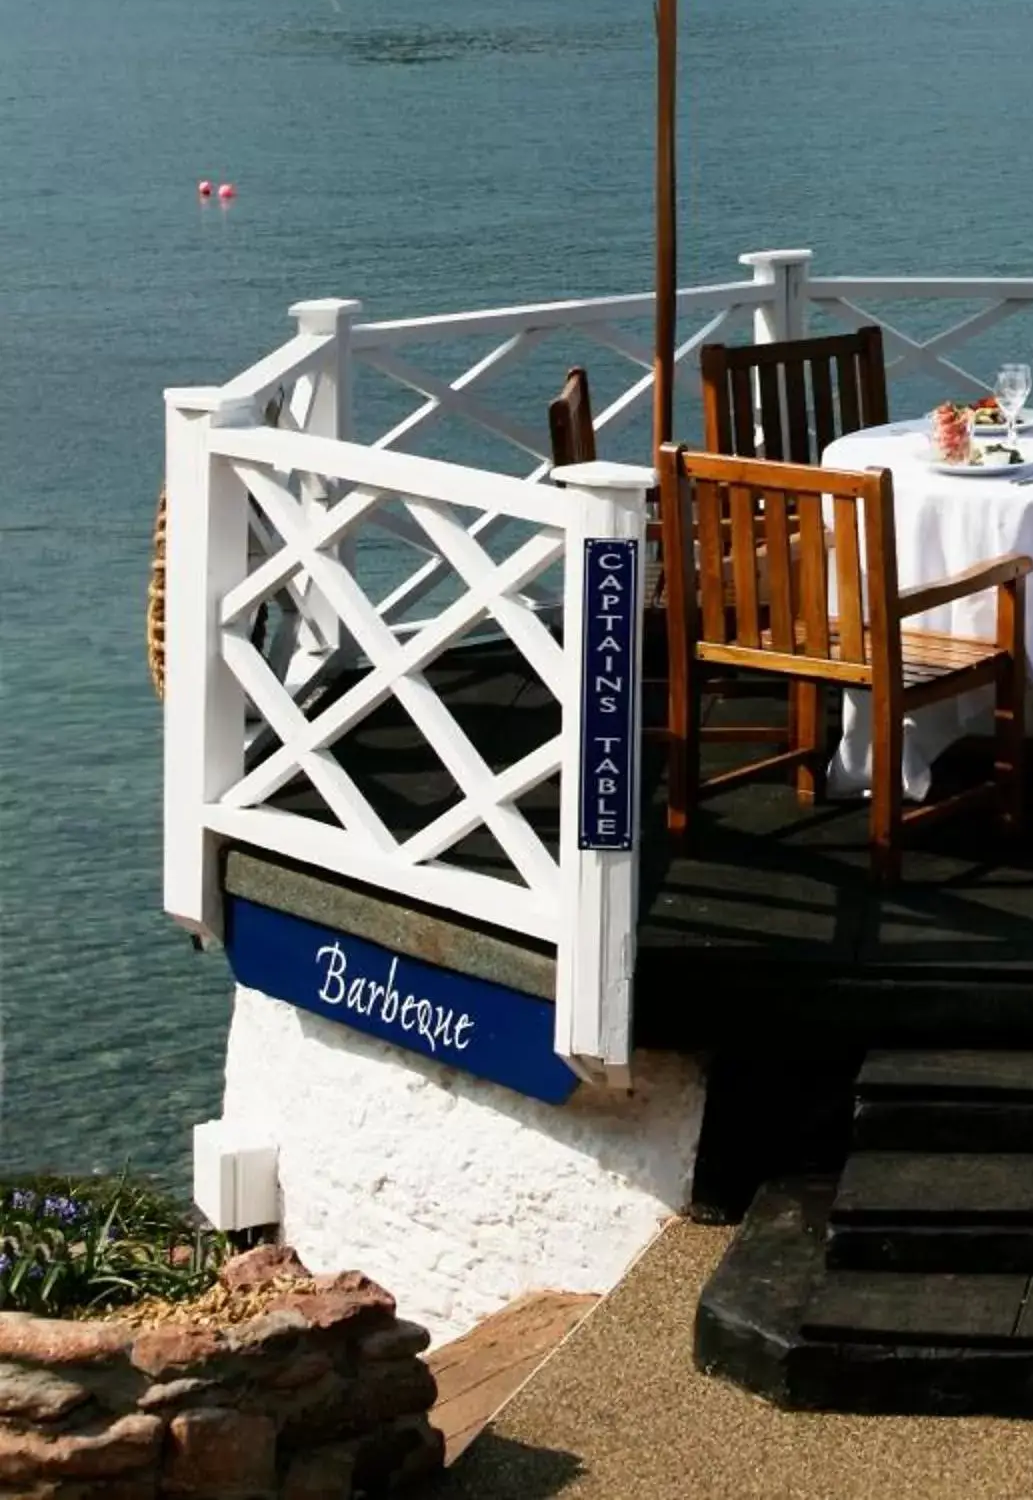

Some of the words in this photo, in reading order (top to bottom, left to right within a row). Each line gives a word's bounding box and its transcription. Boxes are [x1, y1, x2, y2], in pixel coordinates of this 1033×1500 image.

[595, 553, 624, 713] CAPTAINS
[594, 737, 621, 836] TABLE
[316, 940, 475, 1052] Barbeque
